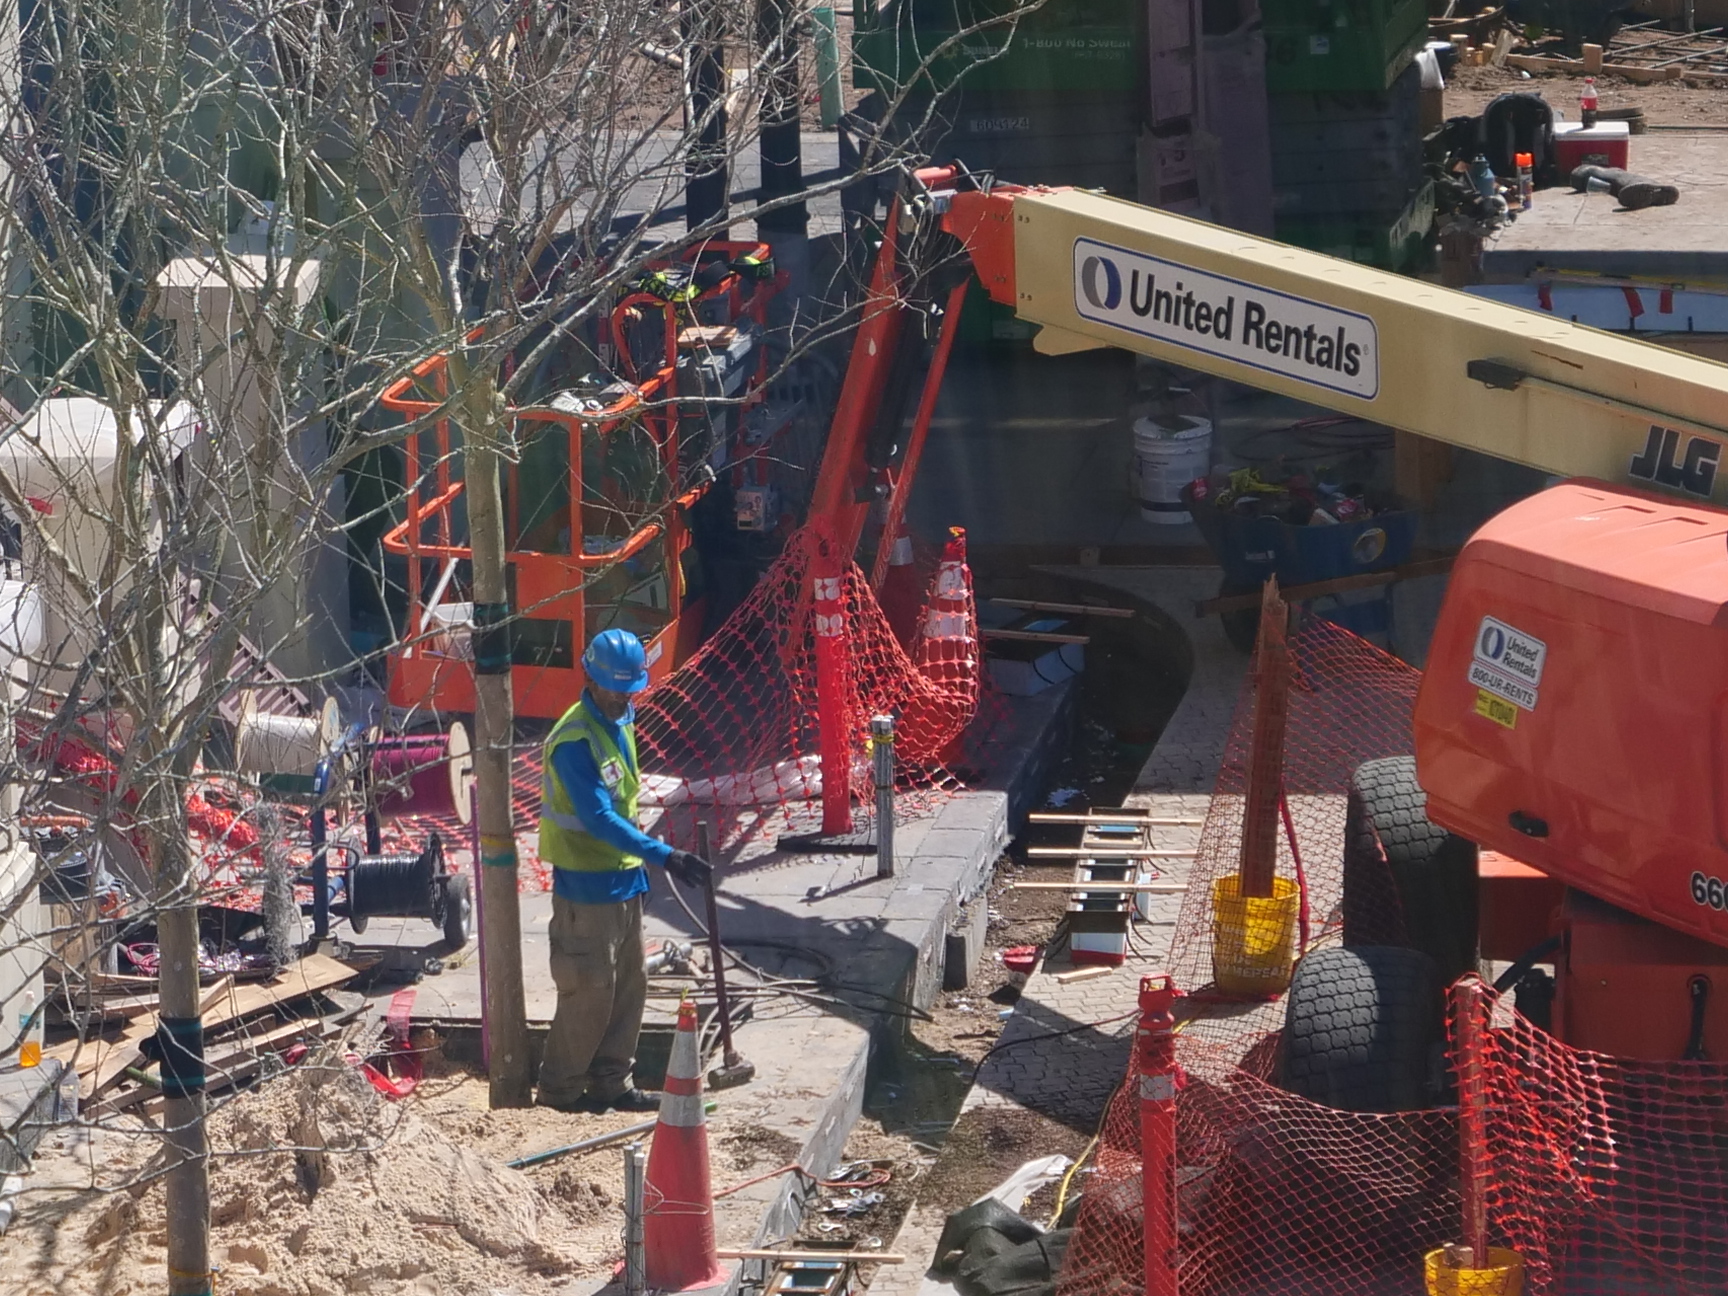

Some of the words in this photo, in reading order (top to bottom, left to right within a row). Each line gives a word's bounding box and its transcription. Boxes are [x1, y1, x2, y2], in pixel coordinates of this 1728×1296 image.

[1130, 269, 1233, 341] United
[1242, 300, 1361, 377] Rentals
[1629, 424, 1721, 498] JLG
[1502, 651, 1537, 679] Rentals
[1507, 636, 1539, 661] United
[1472, 667, 1534, 705] 800-UR-RENTS
